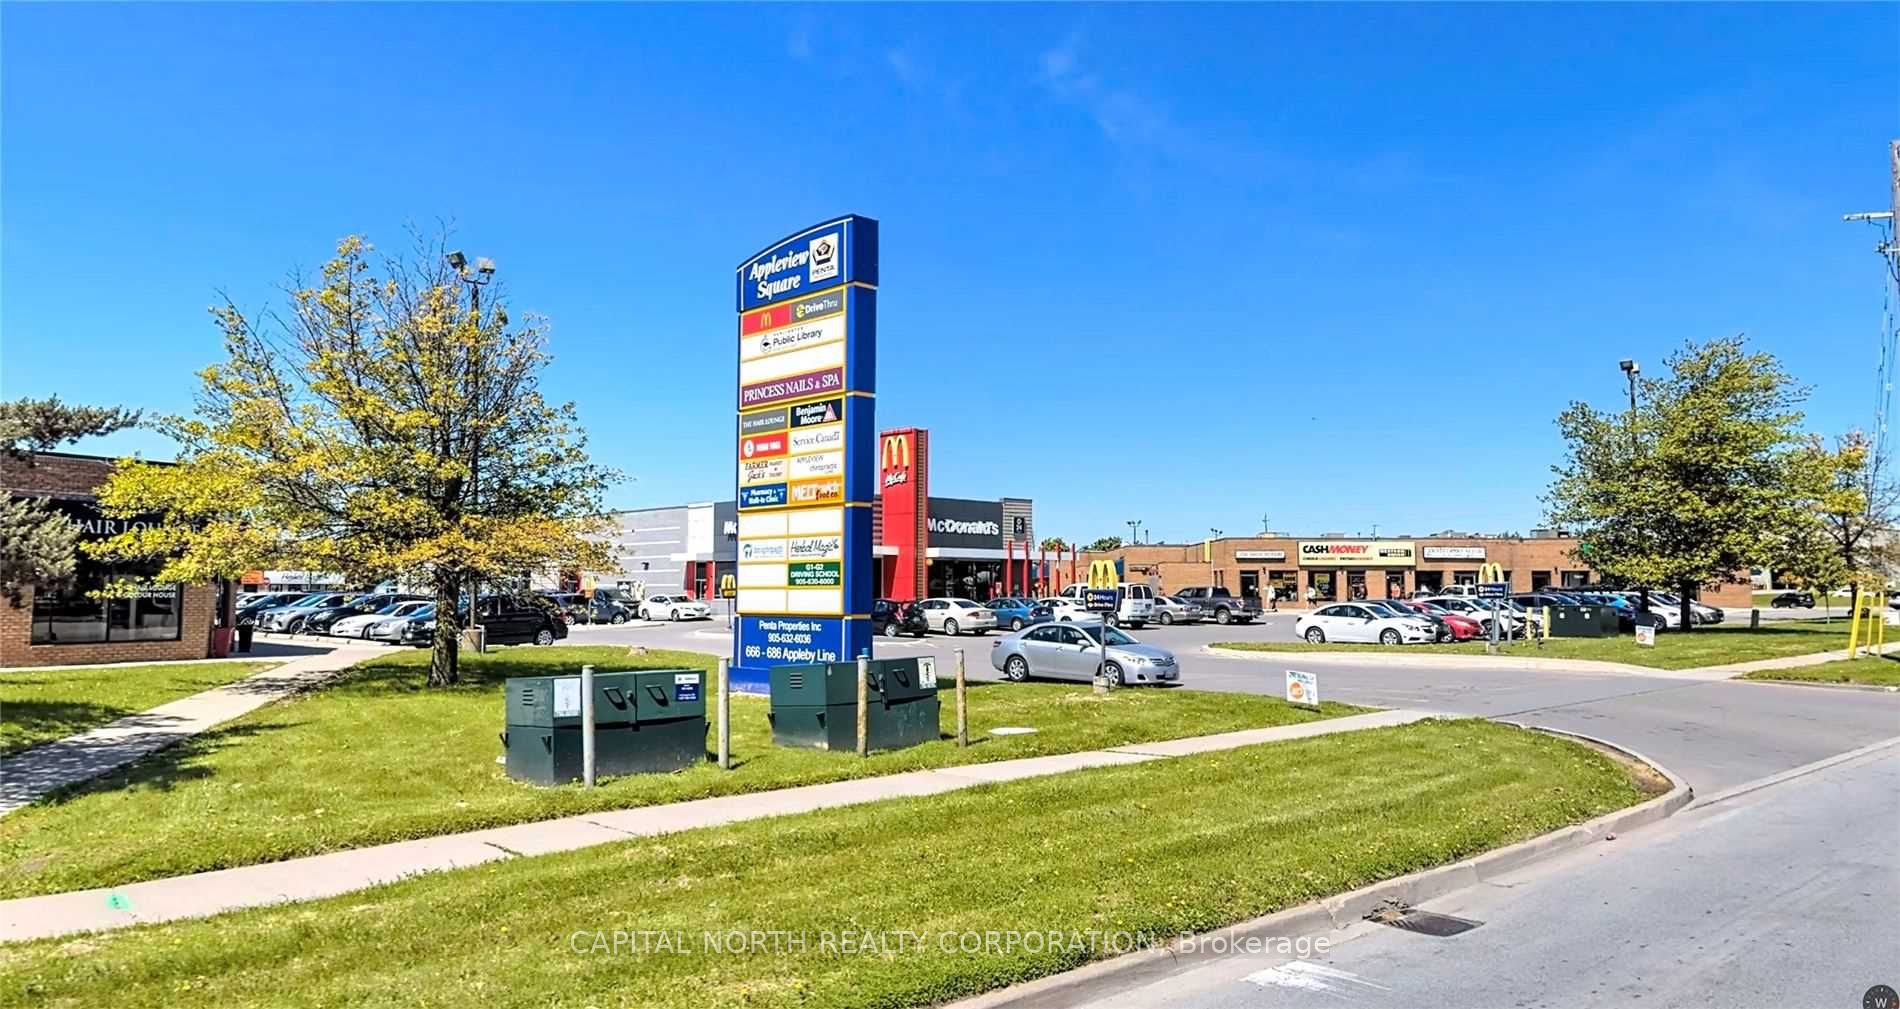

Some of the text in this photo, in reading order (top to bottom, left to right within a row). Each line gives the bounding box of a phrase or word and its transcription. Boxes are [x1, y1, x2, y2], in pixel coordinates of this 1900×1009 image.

[750, 251, 808, 281] Appleview
[812, 264, 835, 276] PENTA
[757, 274, 801, 300] Square
[773, 336, 795, 346] Public
[796, 329, 823, 341] Library
[744, 383, 785, 402] PRINCESS
[785, 377, 814, 395] NAILS
[822, 373, 840, 388] SPA
[796, 403, 826, 417] Benjamin
[800, 415, 822, 426] Moore
[793, 435, 815, 448] Service
[928, 518, 999, 536] McDonald's
[790, 539, 835, 557] Herbal Magic
[759, 620, 822, 632] Penta Properties Inc
[745, 646, 761, 657] 666
[766, 647, 782, 659] 686
[782, 647, 816, 664] Appleby
[817, 649, 837, 662] Line
